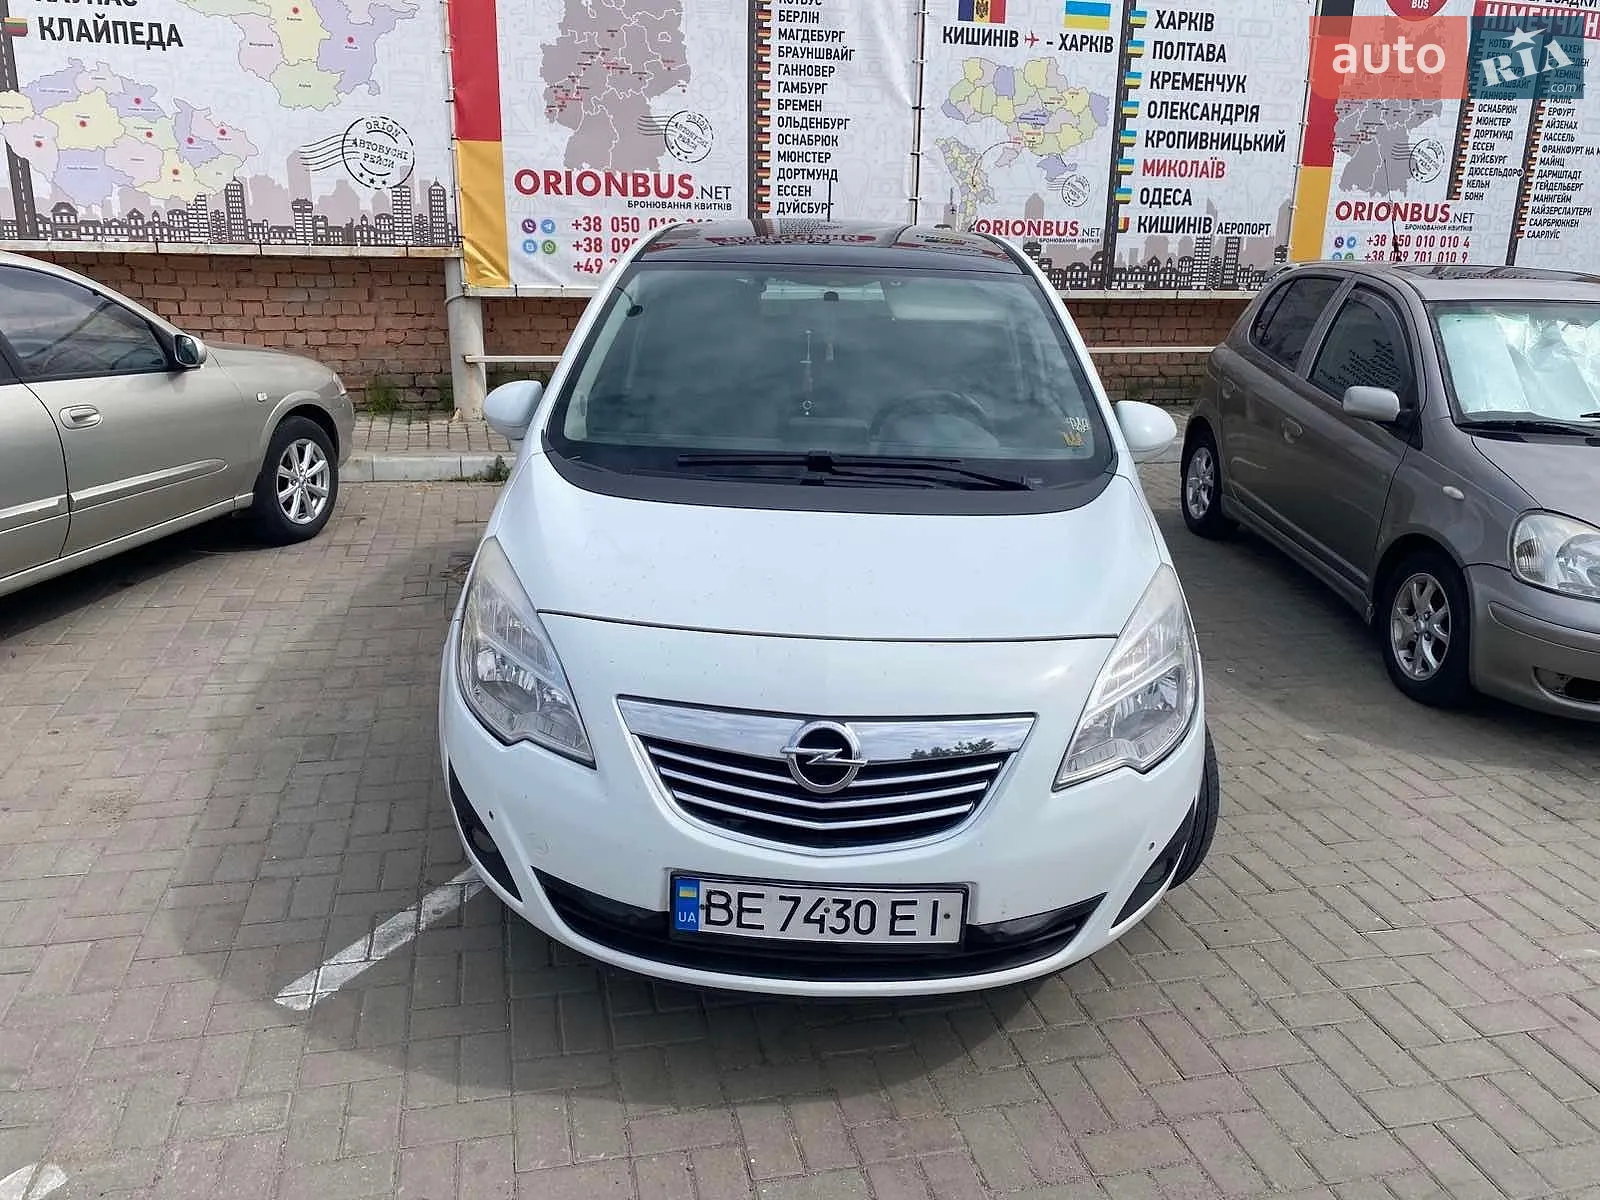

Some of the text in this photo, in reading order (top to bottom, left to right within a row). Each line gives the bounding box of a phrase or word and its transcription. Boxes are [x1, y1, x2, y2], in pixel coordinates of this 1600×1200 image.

[778, 10, 820, 24] БЕРЛІН
[1154, 9, 1215, 32] ХАРКІВ
[38, 13, 183, 51] КЛАЙПЕДА
[778, 28, 845, 43] МАГДЕБУРГ
[942, 25, 1019, 48] КИШИНІВ
[1058, 33, 1114, 53] ХАРКІВ
[1489, 39, 1513, 49] КОТБУ
[778, 46, 855, 60] БРАУНШВАЙГ
[1152, 40, 1227, 63] ПОЛТАВА
[777, 64, 835, 78] ГАННОВЕР
[777, 81, 828, 94] ГАМБУРГ
[1150, 71, 1247, 93] КРЕМЕНЧУК
[777, 99, 822, 112] БРЕМЕН
[1147, 100, 1260, 125] ОЛЕКСАНДРІЯ
[1478, 103, 1518, 114] ОСНАБРЮК
[1548, 107, 1576, 116] ЕРФУРТ
[365, 120, 400, 137] ORION
[777, 116, 851, 130] ОЛЬДЕНБУРГ
[1476, 117, 1511, 126] МЮНСТЕР
[777, 133, 839, 147] ОСНАБРЮК
[1145, 129, 1285, 154] КРОПИВНИЦЬКИЙ
[1473, 129, 1514, 140] ДОРТМУНД
[1543, 132, 1575, 142] КАССЕЛЬ
[1472, 142, 1495, 151] ЕССЕН
[777, 150, 831, 163] МЮНСТЕР
[1470, 153, 1508, 164] ДУЙСБУРГ
[1539, 156, 1565, 167] МАЙНЦ
[1142, 156, 1226, 178] МИКОЛАЇВ
[777, 167, 838, 182] ДОРТМУНД
[777, 185, 811, 196] ЕССЕН
[1140, 188, 1192, 208] ОДЕСА
[628, 200, 732, 211] БРОНЮВАННЯ КВИТКІВ
[777, 199, 834, 215] ДУЙСБУРГ
[572, 216, 602, 232] +38
[611, 217, 640, 233] 050
[1137, 216, 1271, 235] КИШИНІВ АЕРОПОРТ
[572, 238, 603, 253] +38
[1366, 234, 1386, 247] +38
[1416, 235, 1435, 248] 010
[1440, 235, 1459, 248] 010
[1463, 236, 1470, 248] 4
[1414, 251, 1432, 262] 701
[1438, 251, 1457, 262] 010
[1462, 252, 1468, 263] 9
[573, 258, 603, 274] +49
[678, 911, 696, 923] UA
[704, 889, 939, 936] BE 7430 EI
